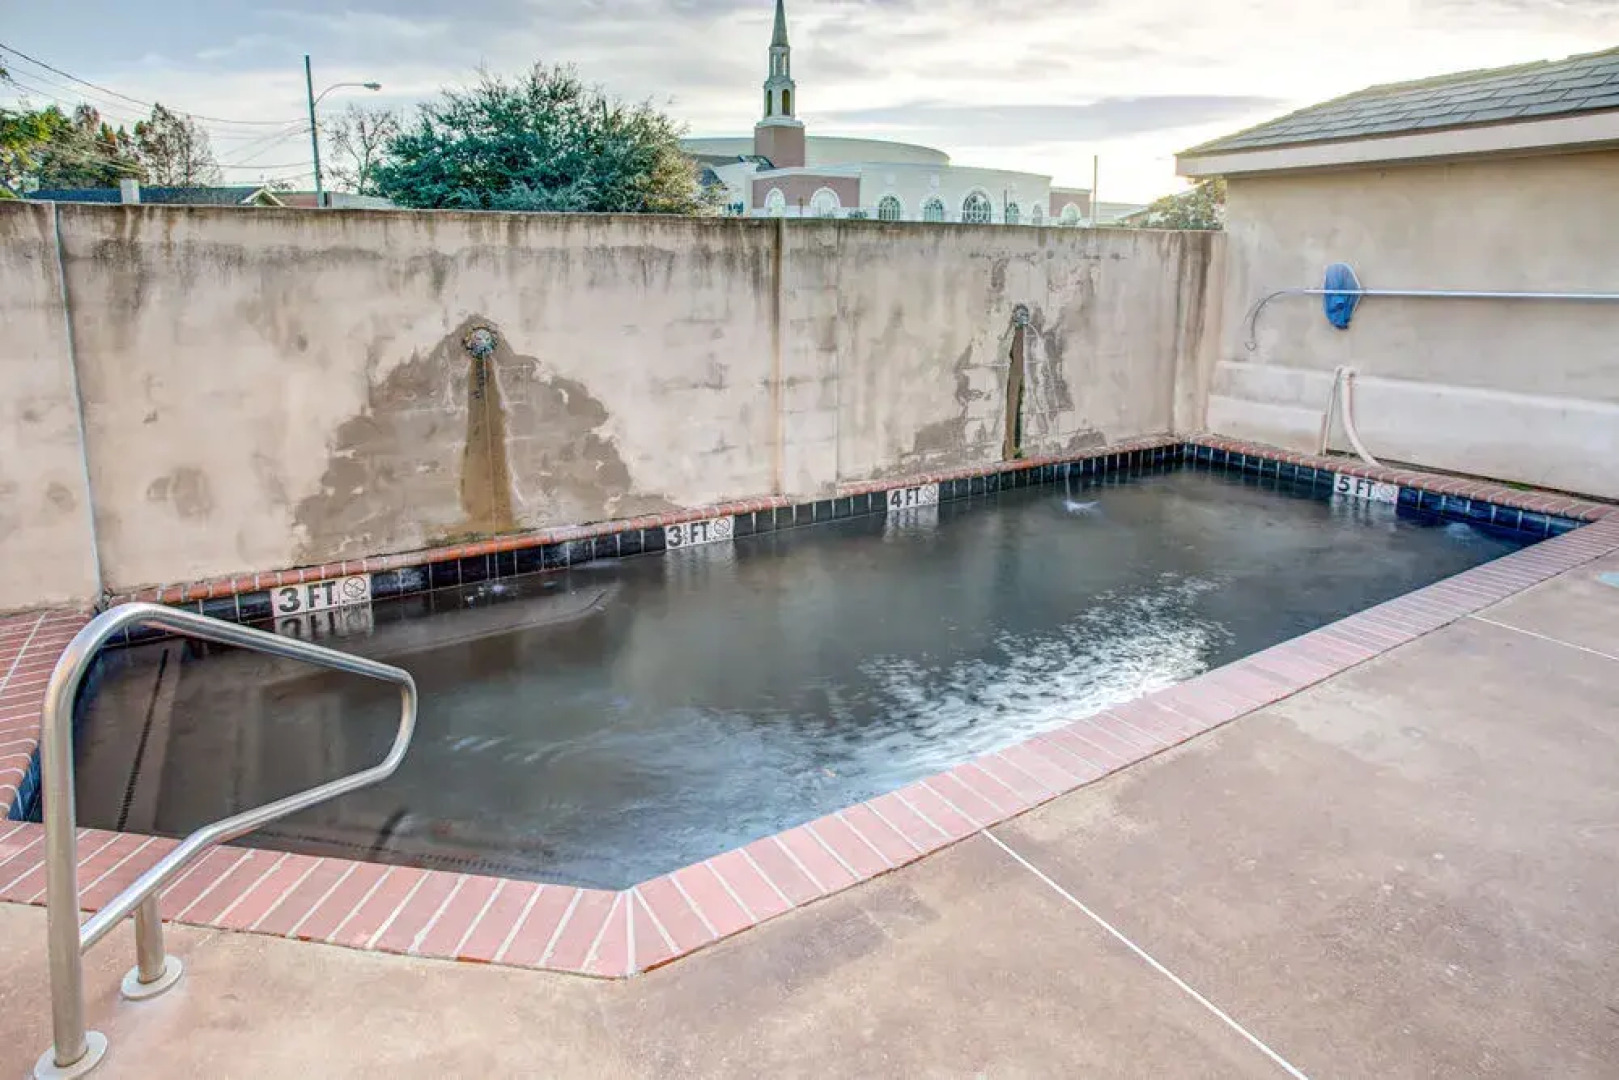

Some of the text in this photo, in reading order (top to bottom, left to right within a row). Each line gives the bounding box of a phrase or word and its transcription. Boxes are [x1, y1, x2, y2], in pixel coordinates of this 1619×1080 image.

[1338, 475, 1350, 493] 5
[890, 490, 902, 507] 4
[668, 525, 682, 547] 3
[279, 587, 300, 612] 3
